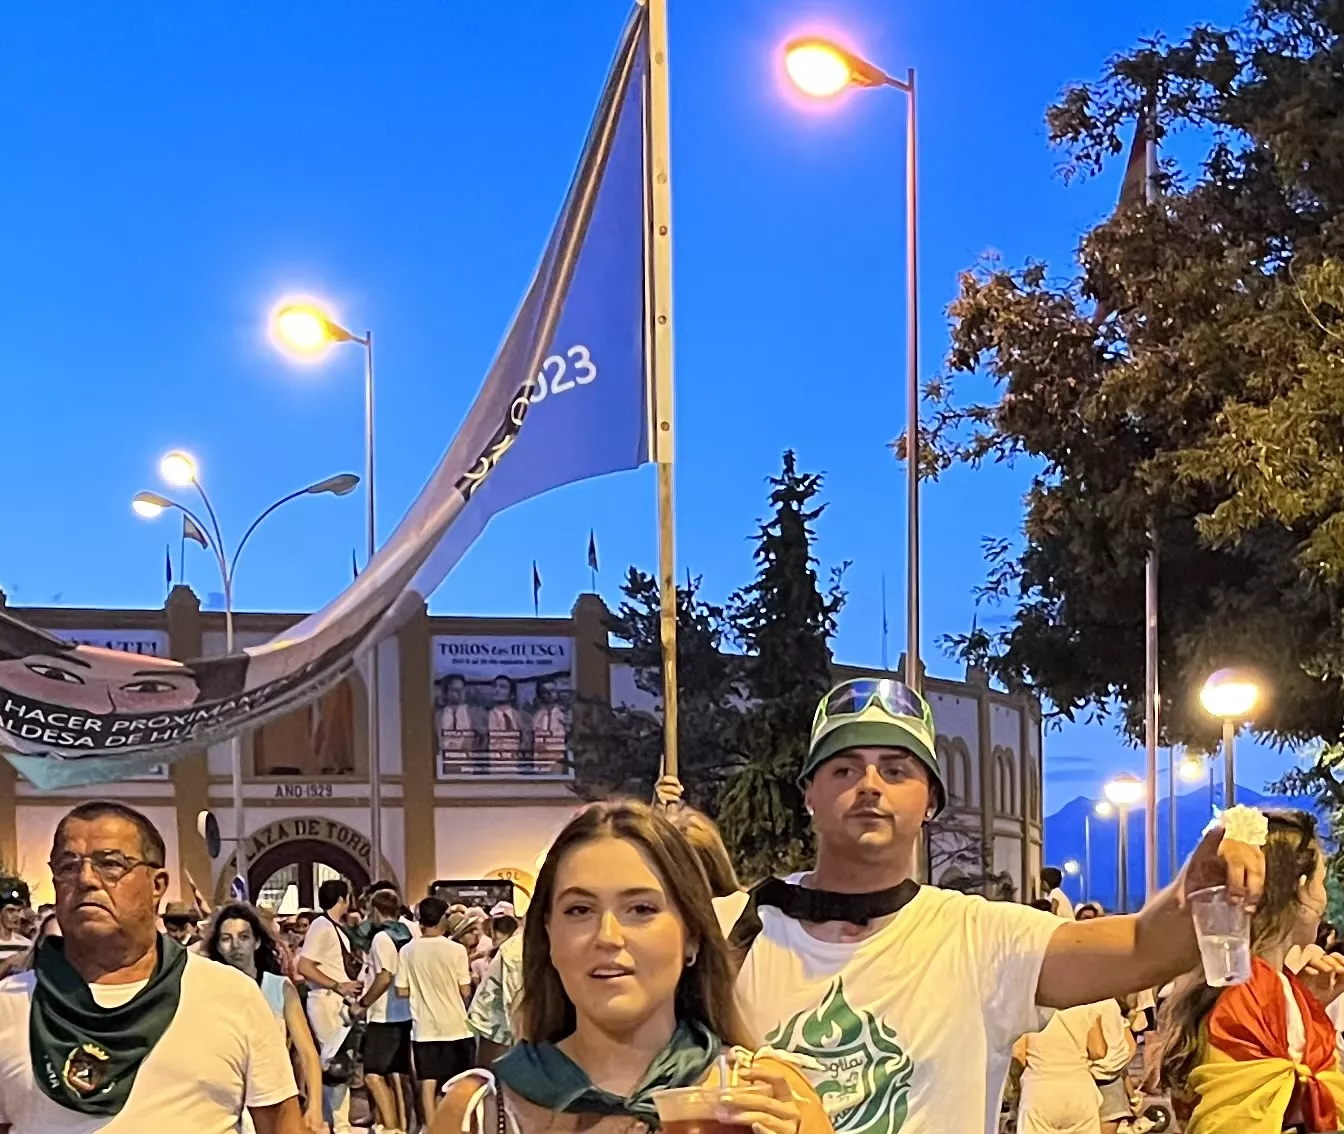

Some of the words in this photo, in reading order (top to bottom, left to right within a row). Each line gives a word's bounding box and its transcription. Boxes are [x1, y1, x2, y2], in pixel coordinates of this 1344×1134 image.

[439, 643, 490, 656] TOROS
[510, 643, 565, 657] HUESCA
[4, 699, 103, 732] HACER
[104, 733, 143, 747] DE
[305, 783, 333, 797] 1929
[294, 819, 320, 836] DE
[497, 871, 521, 881] SOL
